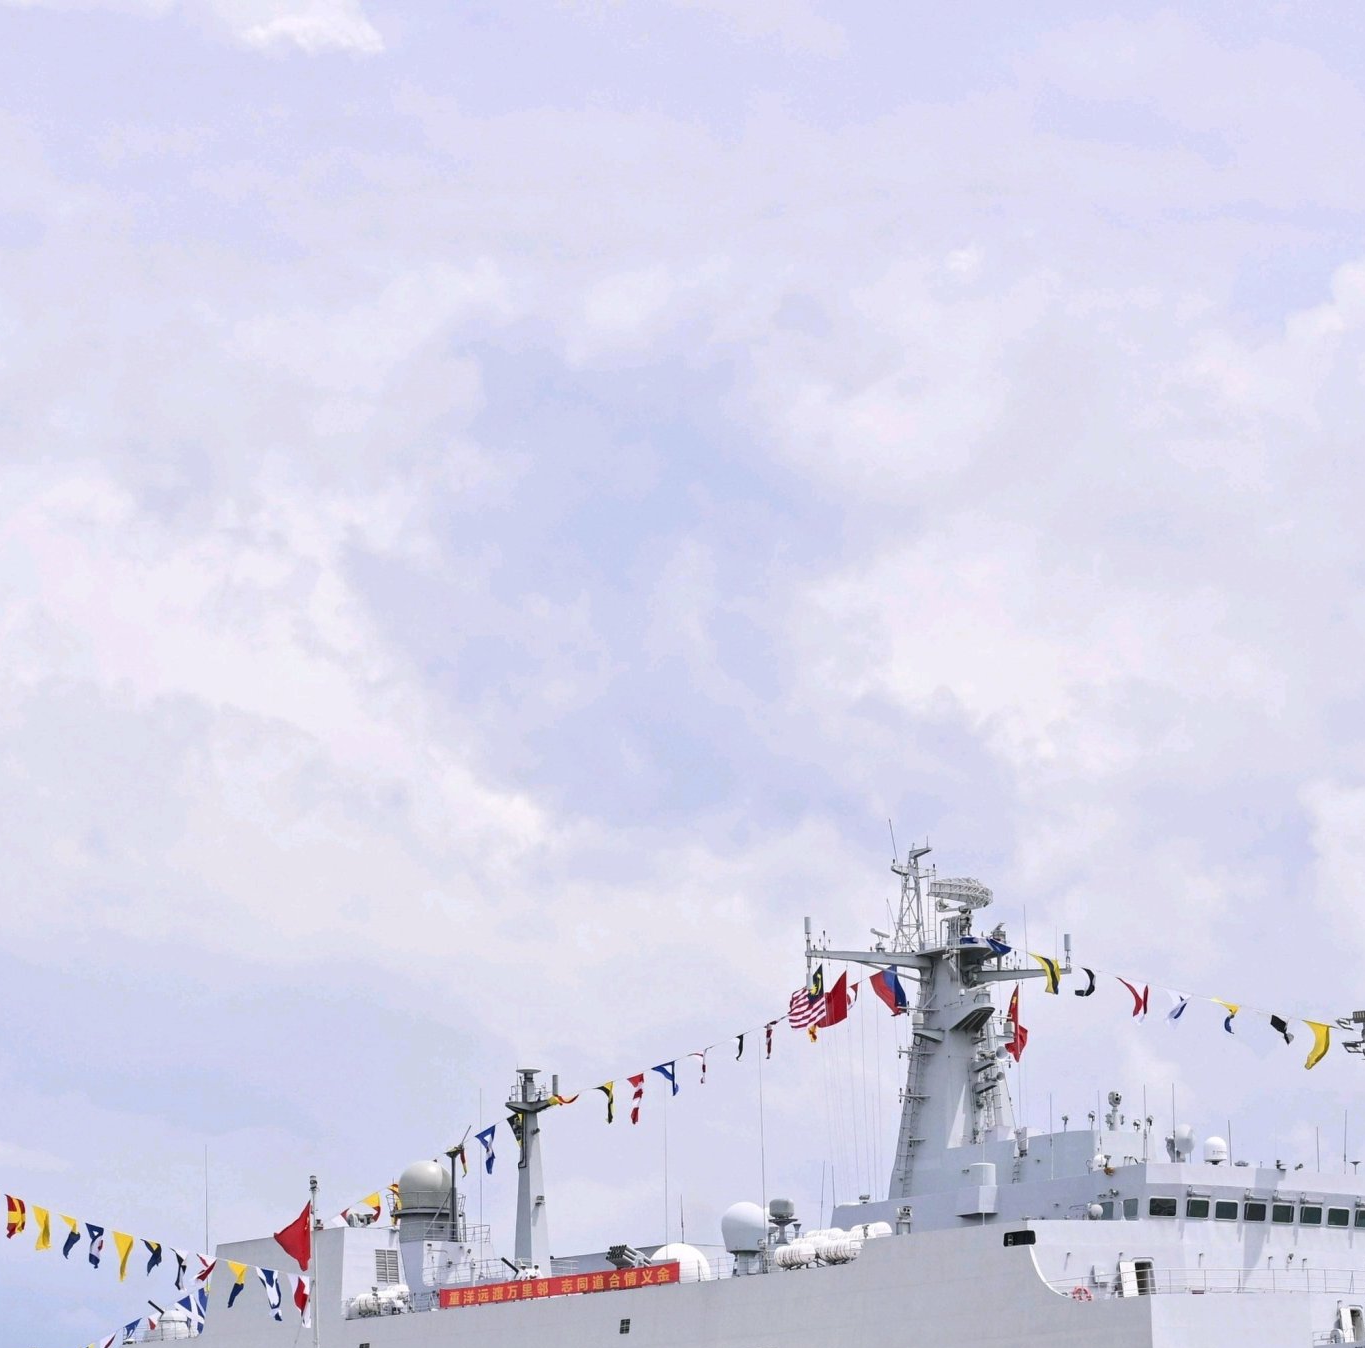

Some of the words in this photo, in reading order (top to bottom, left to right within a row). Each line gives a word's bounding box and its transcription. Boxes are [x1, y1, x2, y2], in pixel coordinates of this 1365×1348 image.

[561, 1267, 671, 1293] 志同道合情义金
